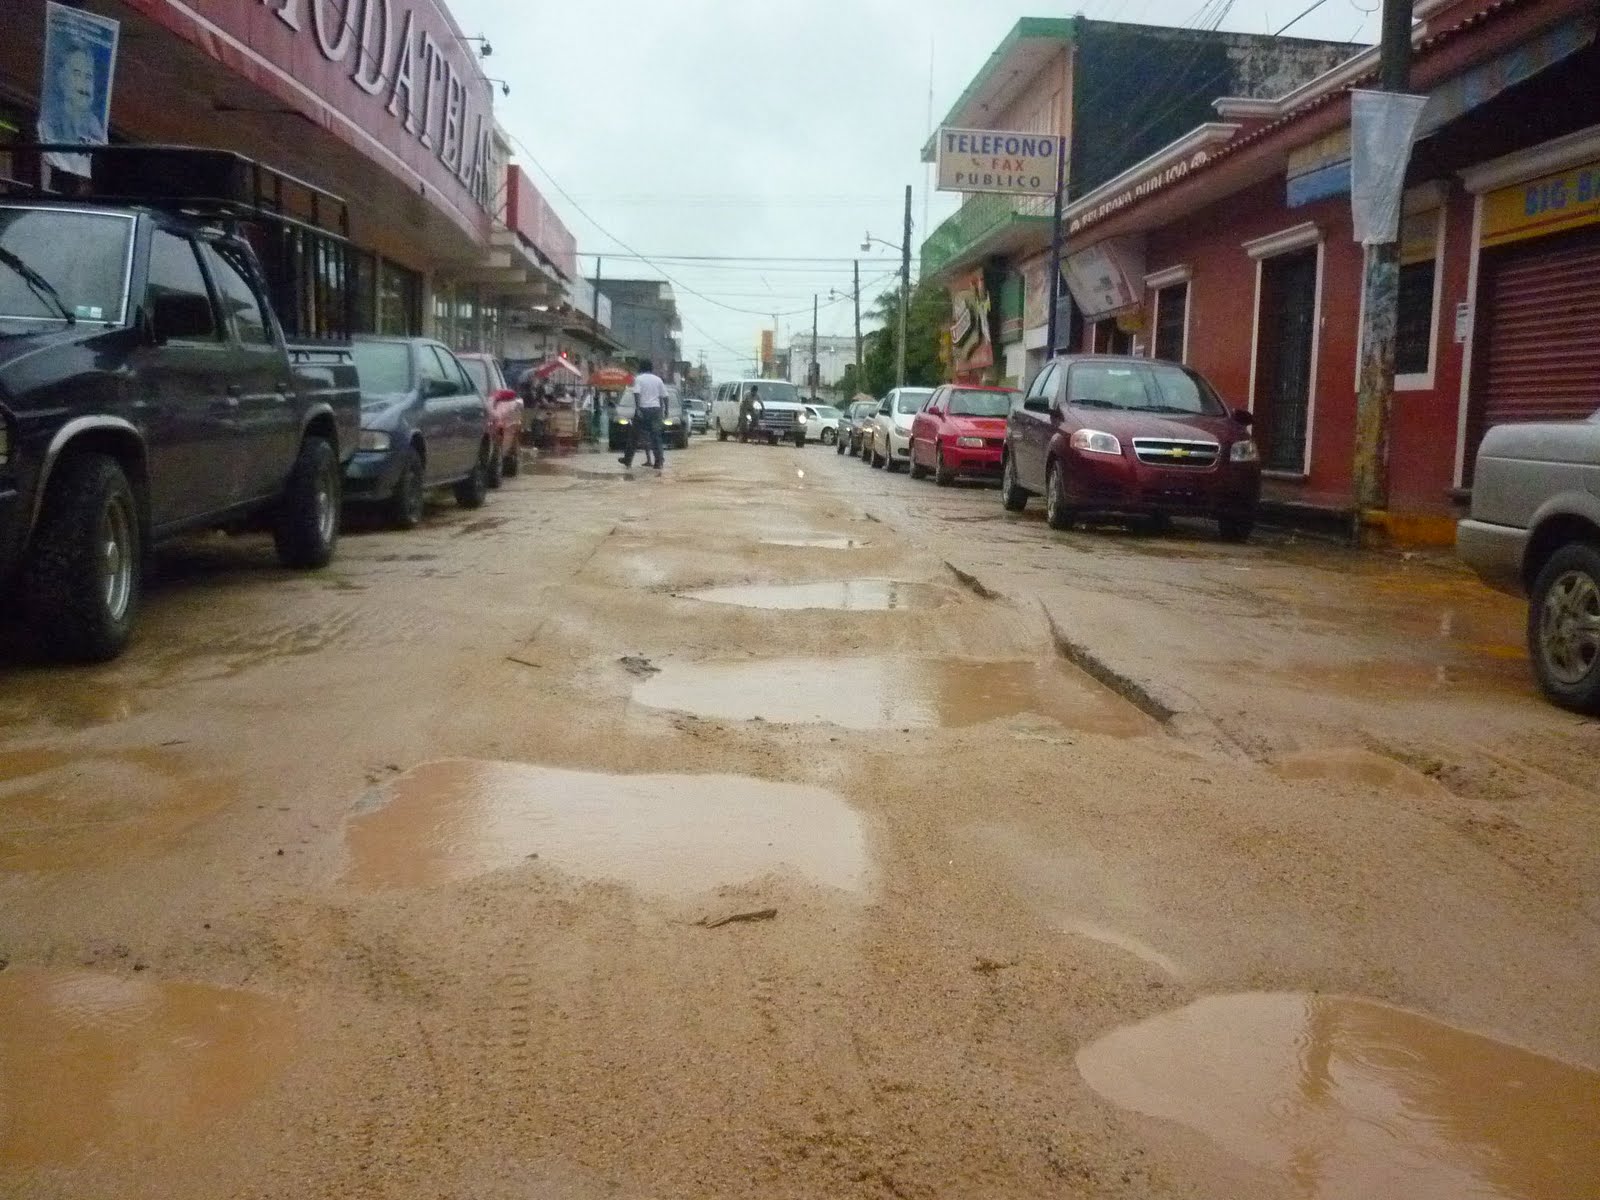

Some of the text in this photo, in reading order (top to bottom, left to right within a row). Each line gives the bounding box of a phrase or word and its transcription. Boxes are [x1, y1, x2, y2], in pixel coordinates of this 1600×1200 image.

[256, 0, 494, 211] DATELAS
[946, 133, 1053, 158] TELEFONO
[992, 158, 1025, 172] FAX
[955, 172, 1040, 188] PUBLICO
